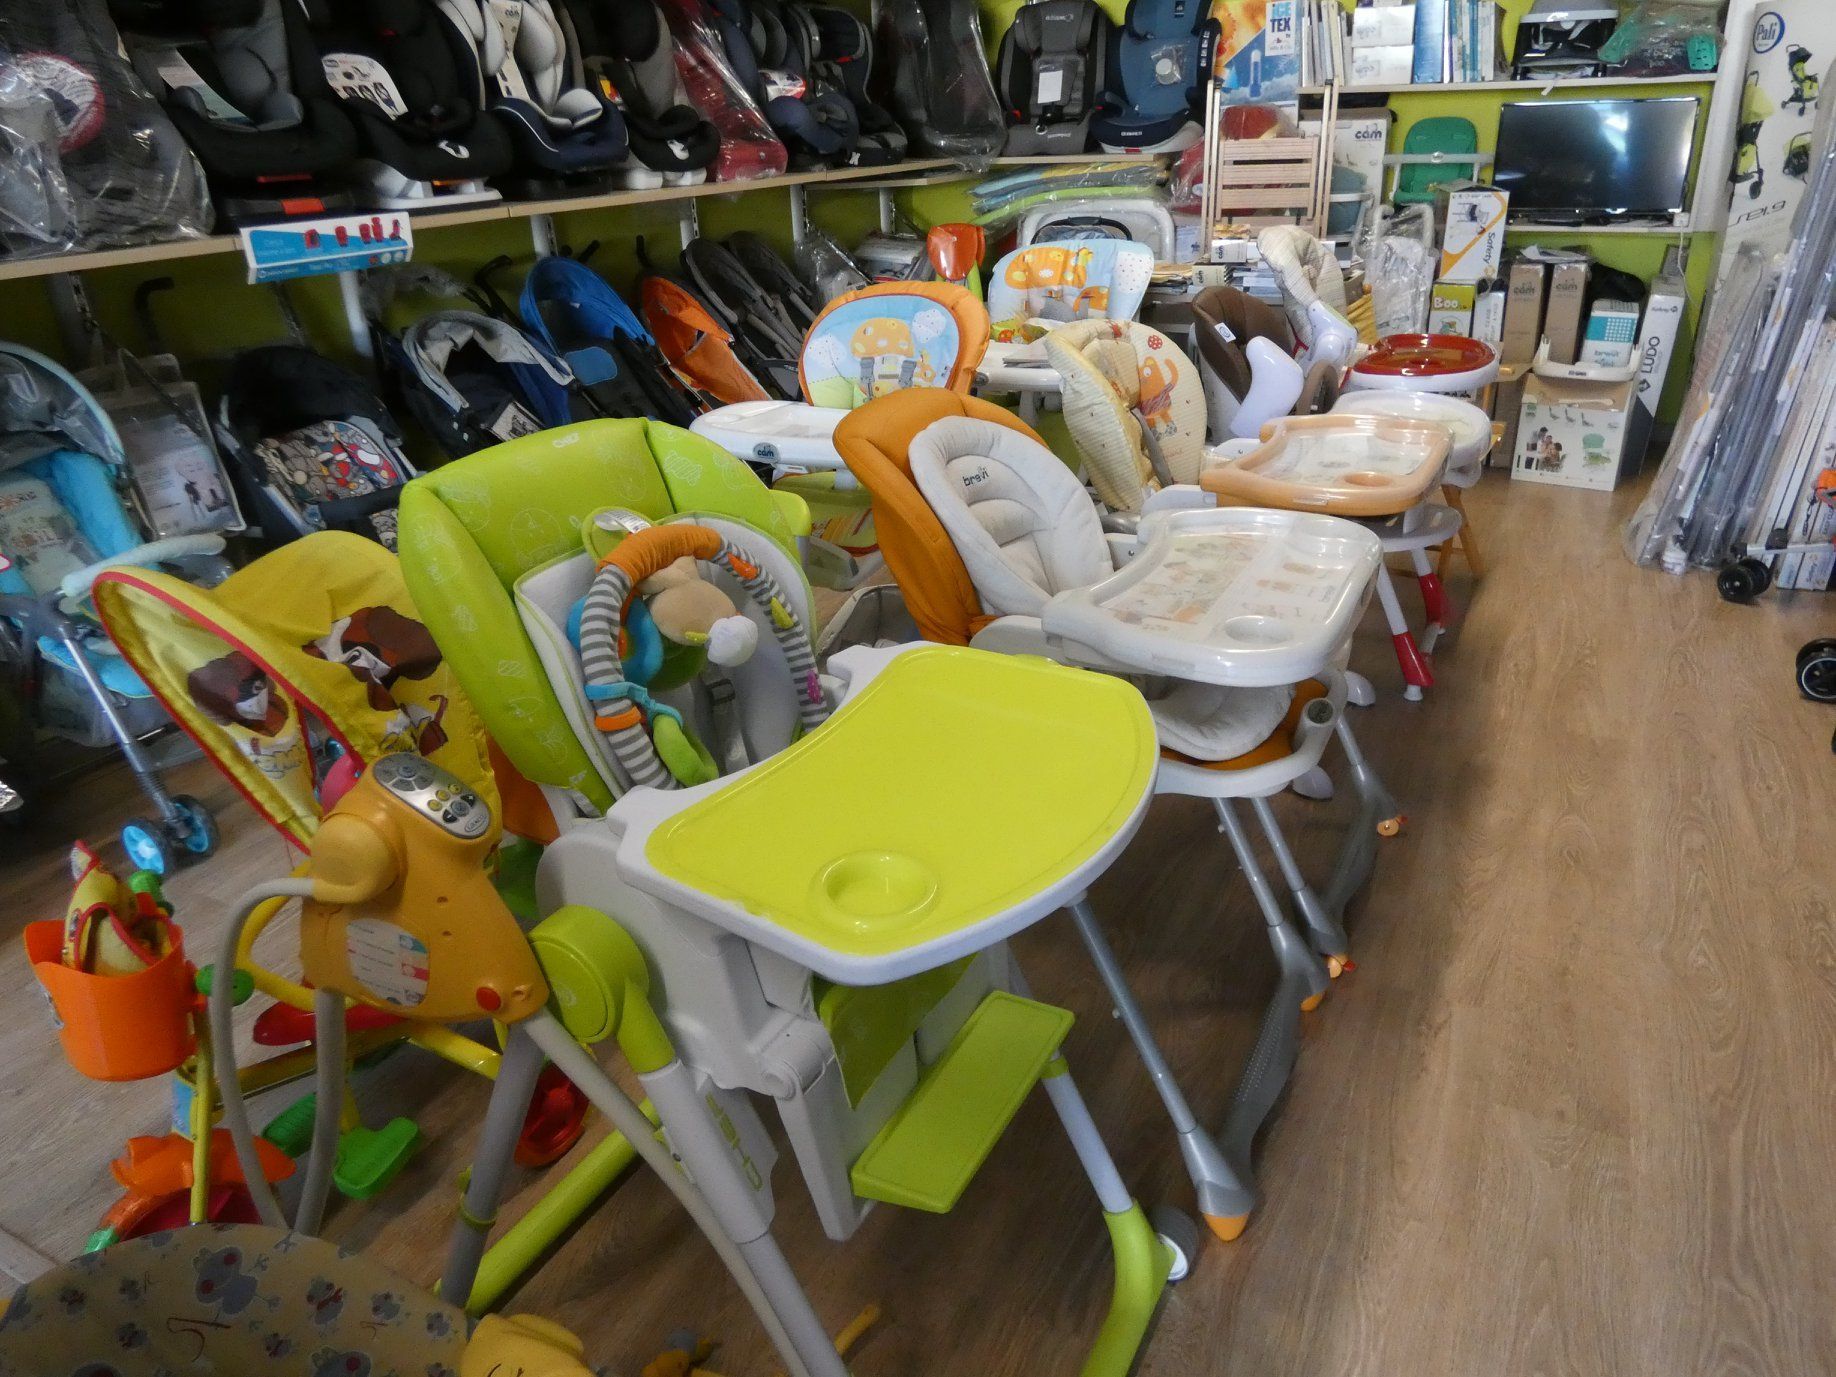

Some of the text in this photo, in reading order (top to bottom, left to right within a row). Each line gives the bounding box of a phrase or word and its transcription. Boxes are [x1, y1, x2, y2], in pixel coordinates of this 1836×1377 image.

[1271, 2, 1291, 18] ICE
[1270, 17, 1291, 33] TEX
[1755, 22, 1778, 41] Pali
[1355, 124, 1382, 139] cam
[1433, 297, 1458, 309] Boo
[1641, 336, 1661, 374] LUDO
[757, 446, 775, 457] cam
[962, 467, 990, 487] brevi
